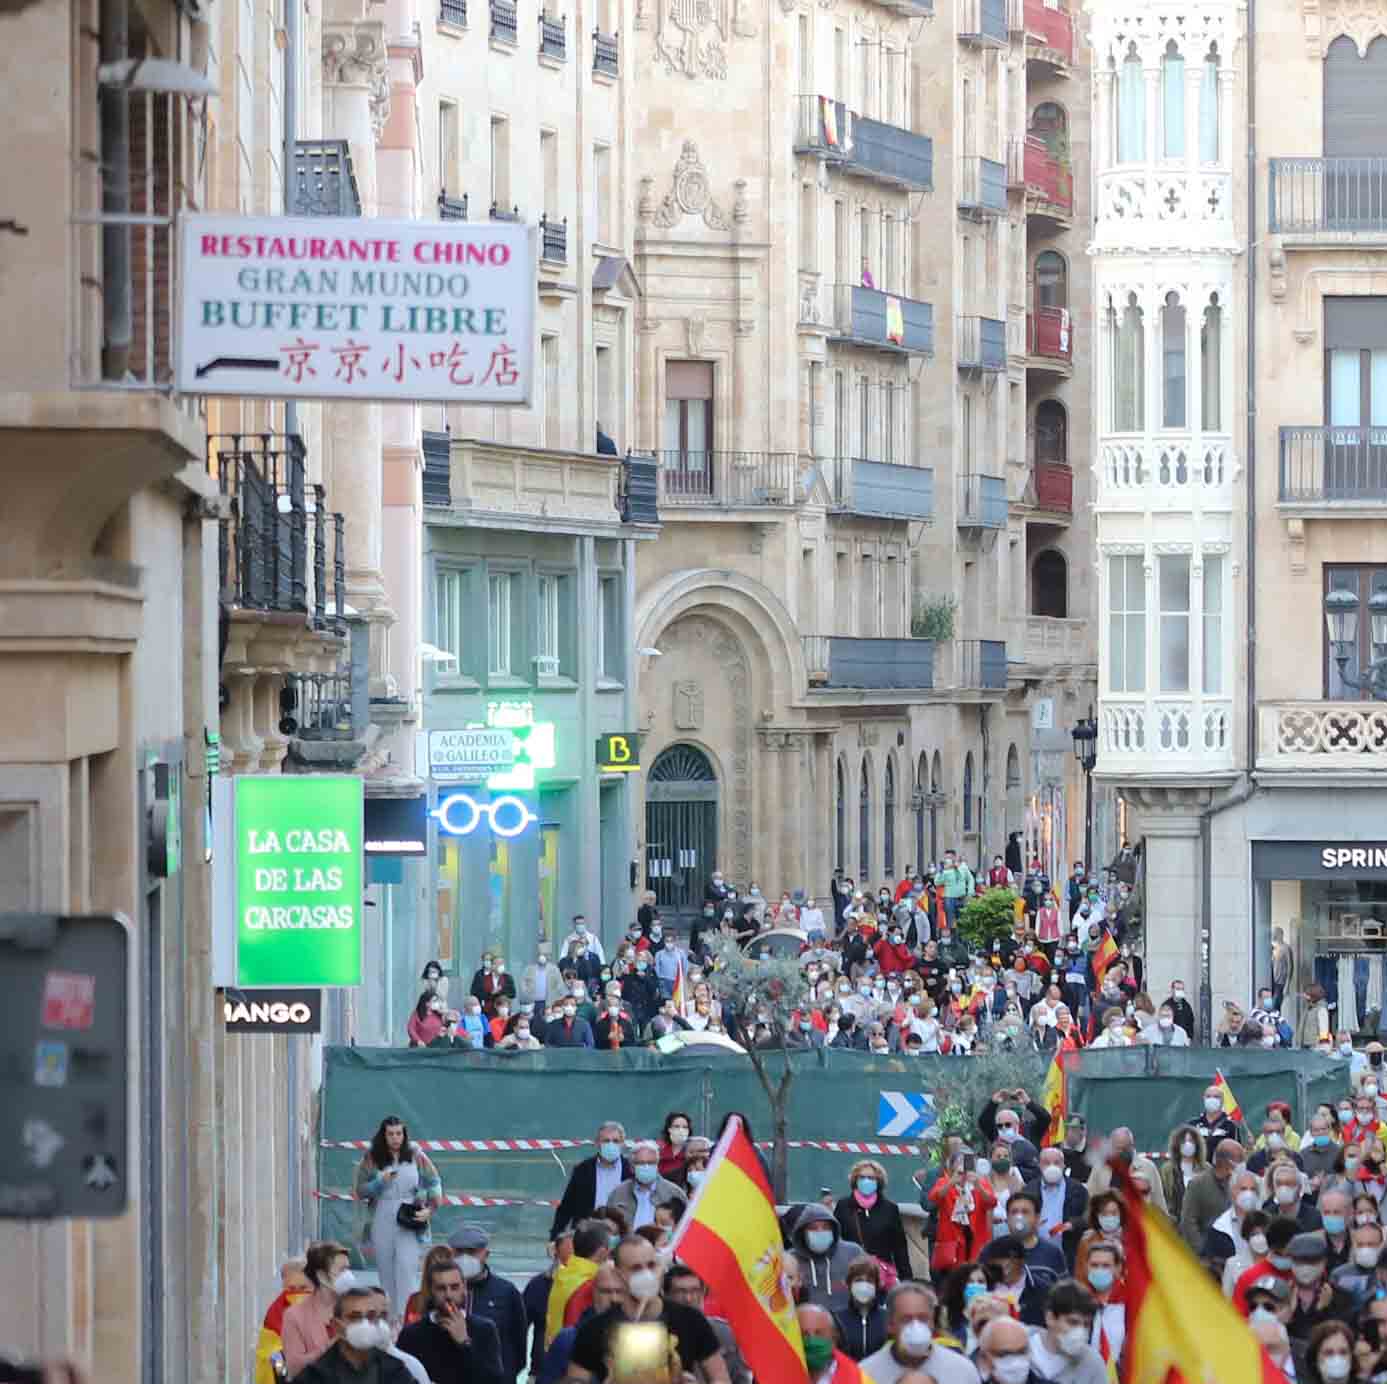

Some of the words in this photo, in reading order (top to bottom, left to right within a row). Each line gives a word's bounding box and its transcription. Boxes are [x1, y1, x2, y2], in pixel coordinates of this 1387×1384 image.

[201, 234, 400, 263] RESTAURANTE
[414, 241, 511, 266] CHINO
[237, 267, 338, 295] GRAN
[351, 271, 470, 298] MUNDO
[201, 300, 368, 330] BUFFET
[380, 305, 507, 335] LIBRE
[280, 338, 521, 386] 京京小吃店
[440, 734, 505, 747] ACADEMIA
[609, 736, 631, 762] B
[248, 829, 282, 853] LA
[286, 828, 352, 854] CASA
[255, 869, 287, 892] DE
[293, 867, 343, 892] LAS
[244, 904, 354, 930] CARCASAS
